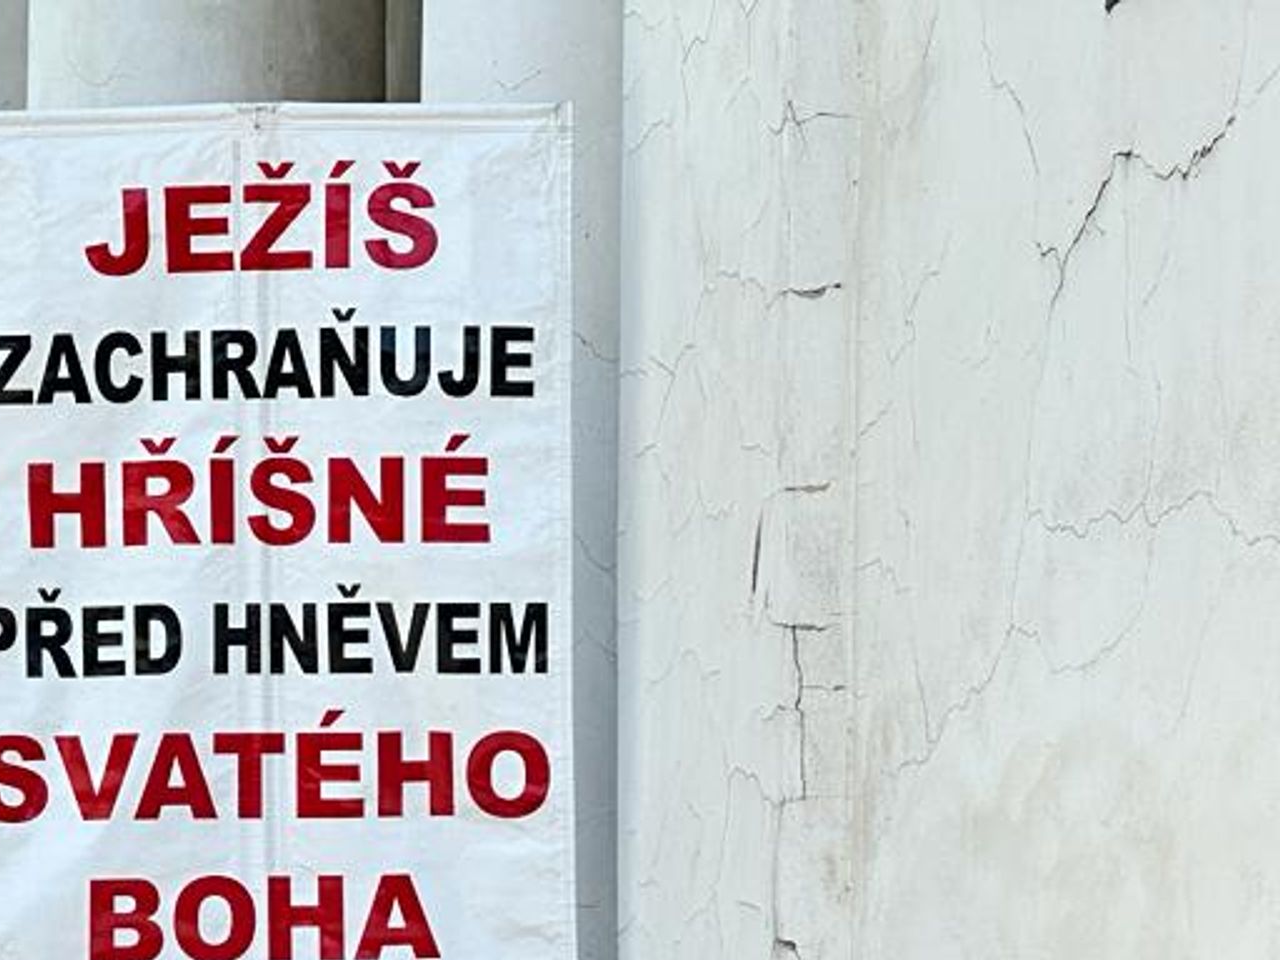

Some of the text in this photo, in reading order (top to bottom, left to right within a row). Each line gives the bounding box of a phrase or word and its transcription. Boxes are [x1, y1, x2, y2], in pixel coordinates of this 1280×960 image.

[85, 160, 438, 276] JEŽÍŠ
[27, 435, 491, 549] HŘÍŠNÉ
[213, 583, 548, 675] HNĚVEM
